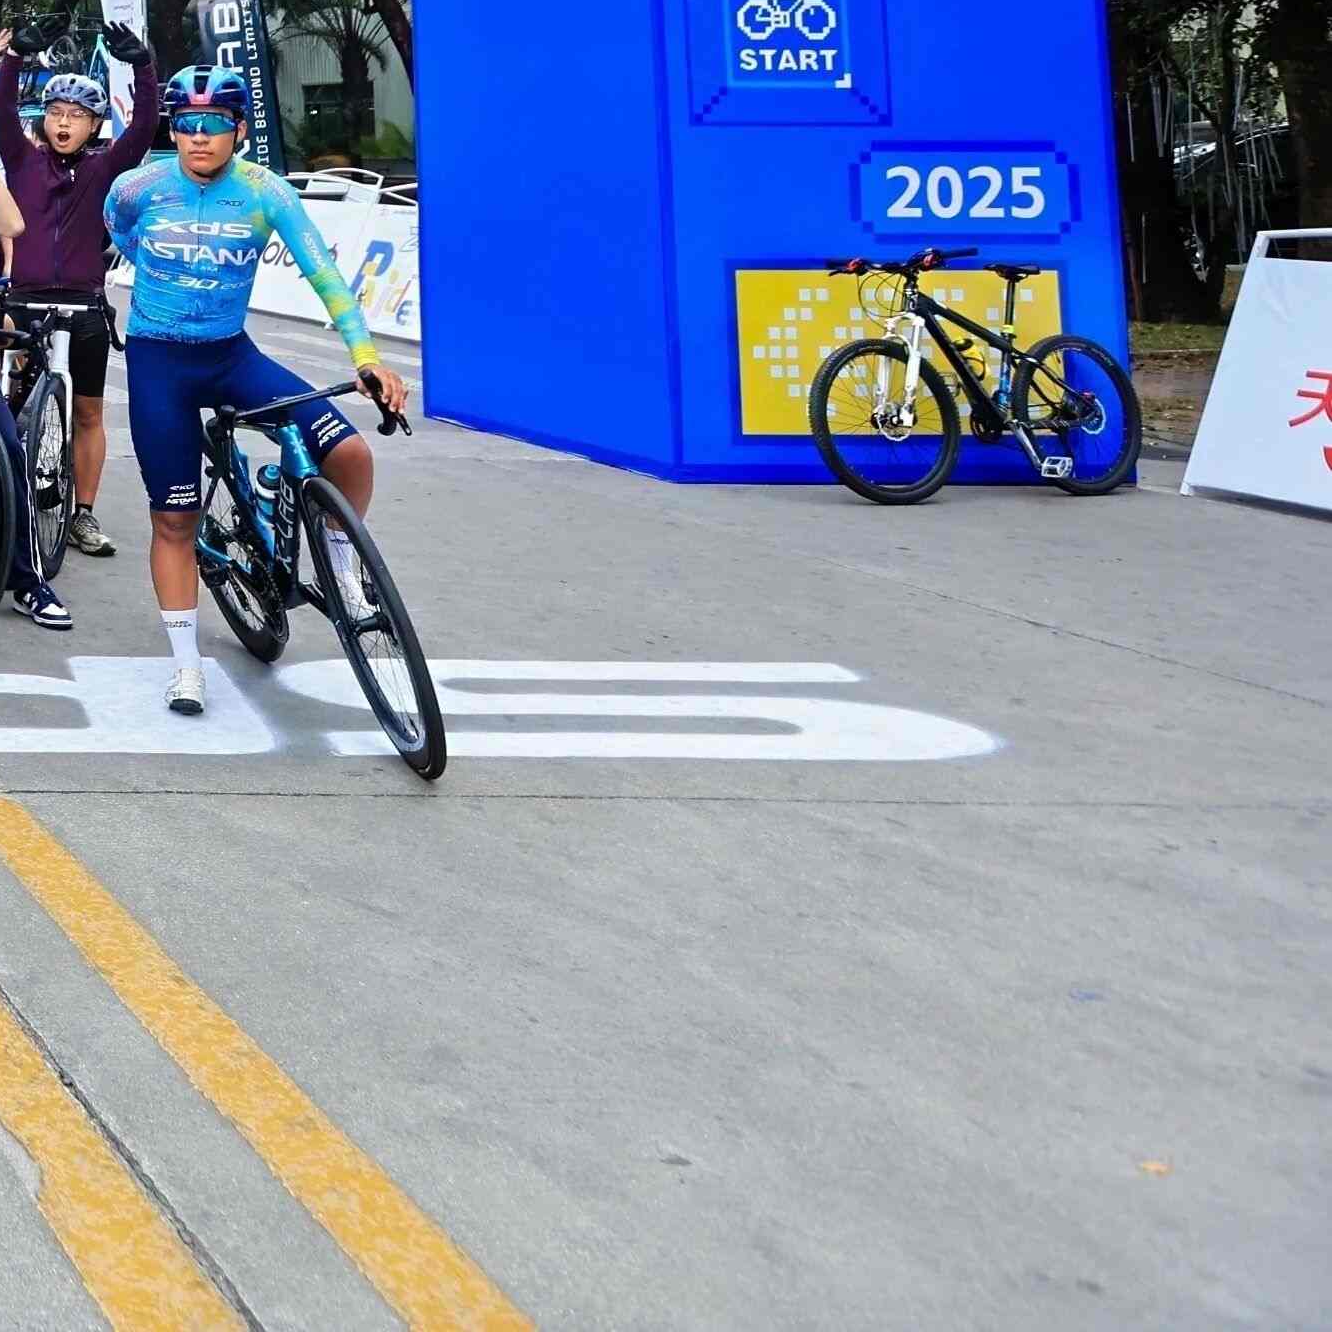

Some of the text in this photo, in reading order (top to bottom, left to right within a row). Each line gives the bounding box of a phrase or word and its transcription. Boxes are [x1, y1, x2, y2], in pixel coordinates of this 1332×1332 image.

[739, 49, 837, 71] START
[249, 67, 268, 129] BEYOND
[257, 134, 270, 168] IDE
[886, 167, 1046, 219] 2025
